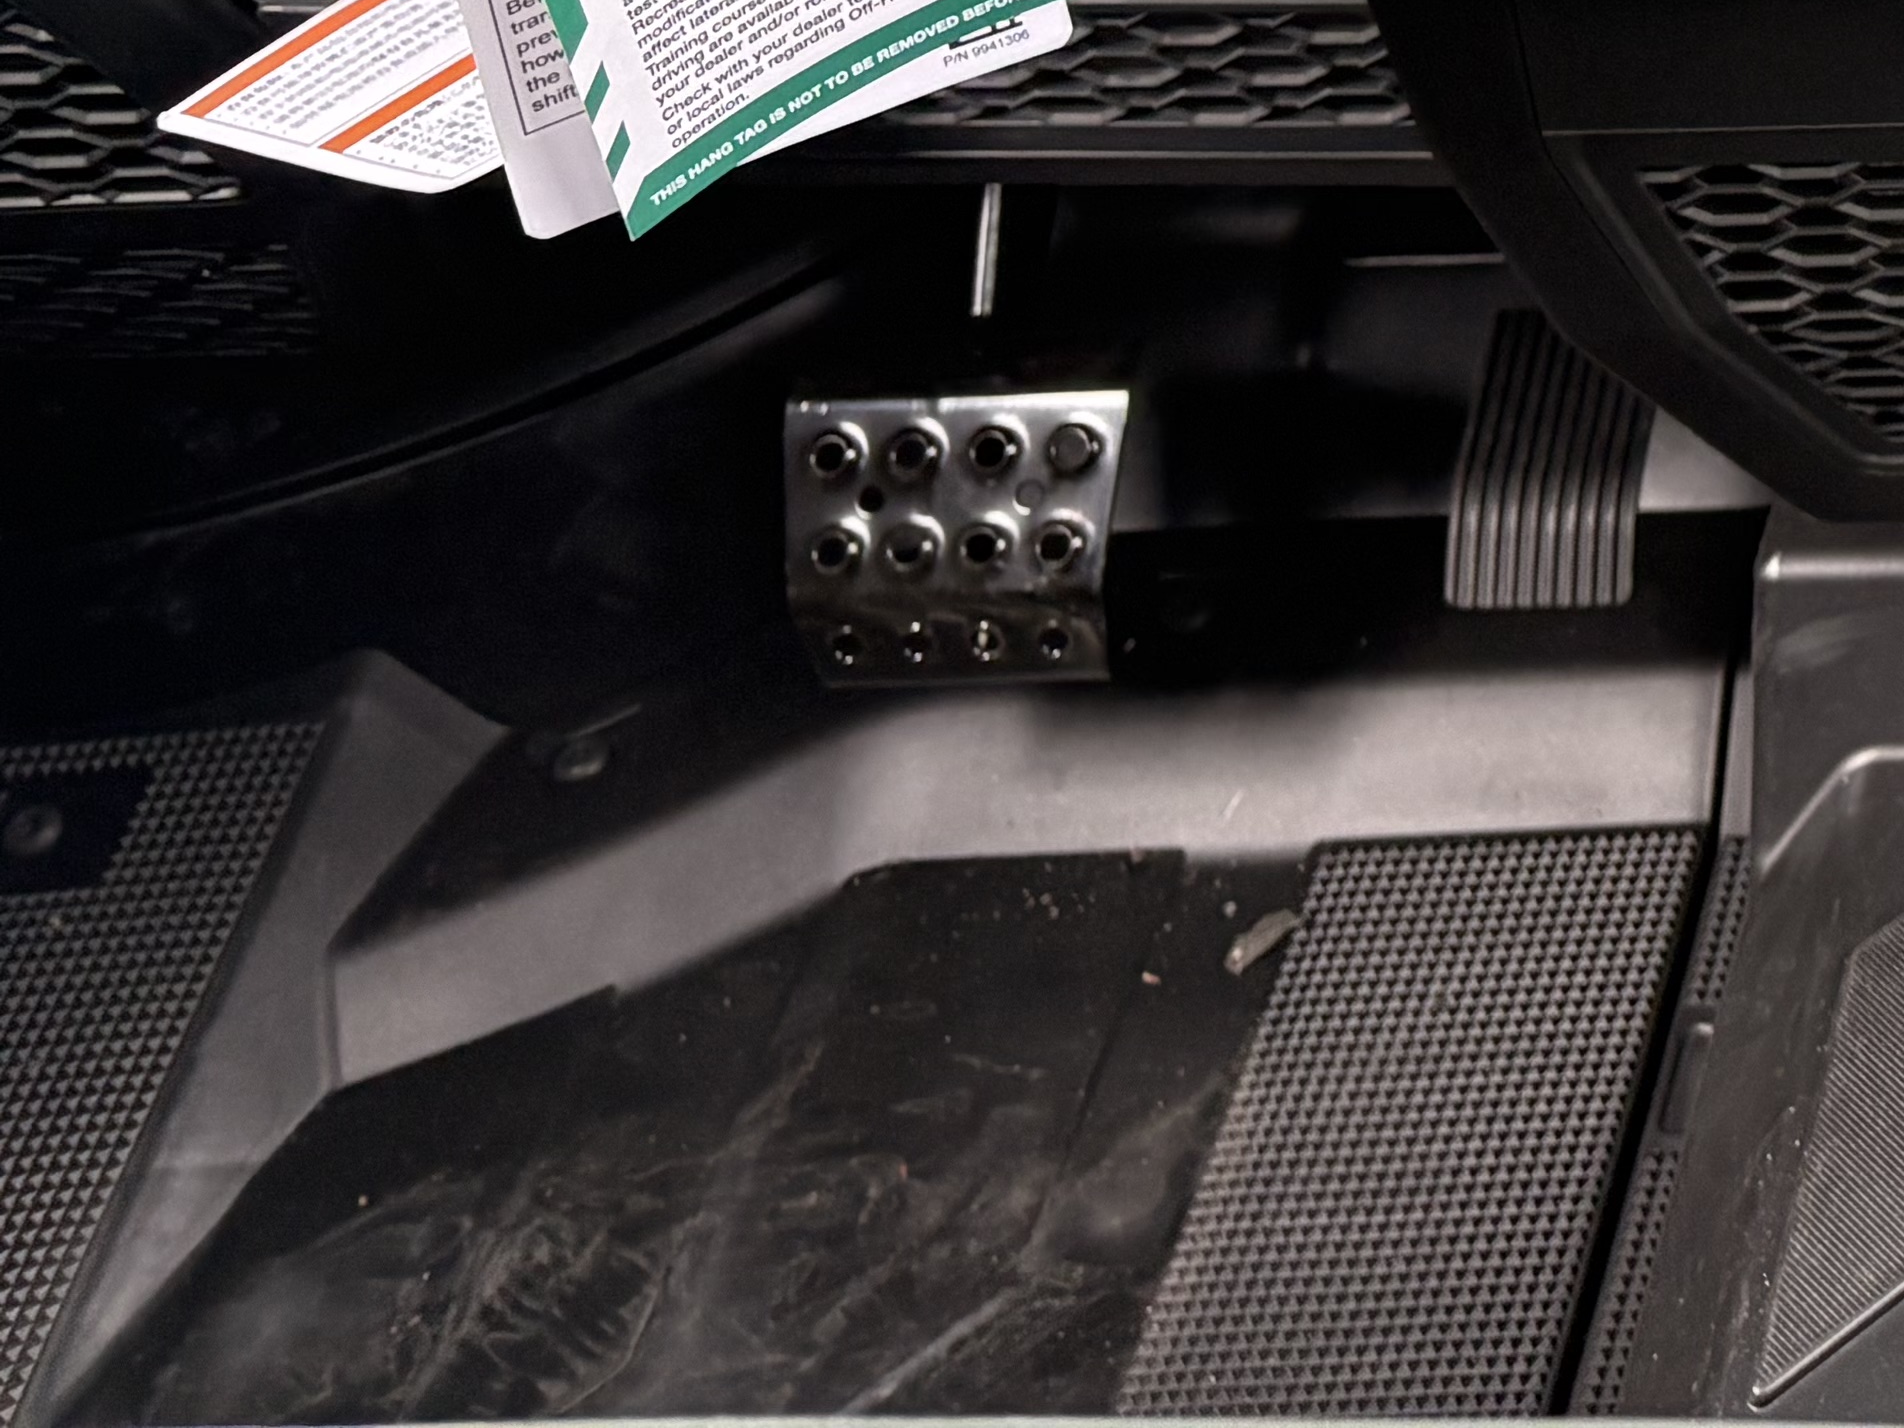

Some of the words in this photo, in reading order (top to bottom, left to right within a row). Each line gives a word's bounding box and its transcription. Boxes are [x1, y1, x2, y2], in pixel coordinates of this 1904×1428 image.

[649, 173, 688, 206] THIS
[687, 141, 734, 180] HANG
[733, 118, 768, 146] TAG
[768, 106, 787, 125] IS
[787, 83, 823, 113] NOT
[823, 70, 849, 90] TO
[850, 55, 876, 77] BE
[876, 14, 960, 64] REMOVED
[661, 82, 713, 122] Check
[713, 58, 750, 85] with
[751, 33, 788, 65] your
[792, 1, 844, 38] dealer
[666, 117, 683, 136] or
[685, 88, 725, 122] local
[726, 65, 765, 94] laws
[767, 18, 846, 69] regarding
[671, 93, 750, 149] operation.
